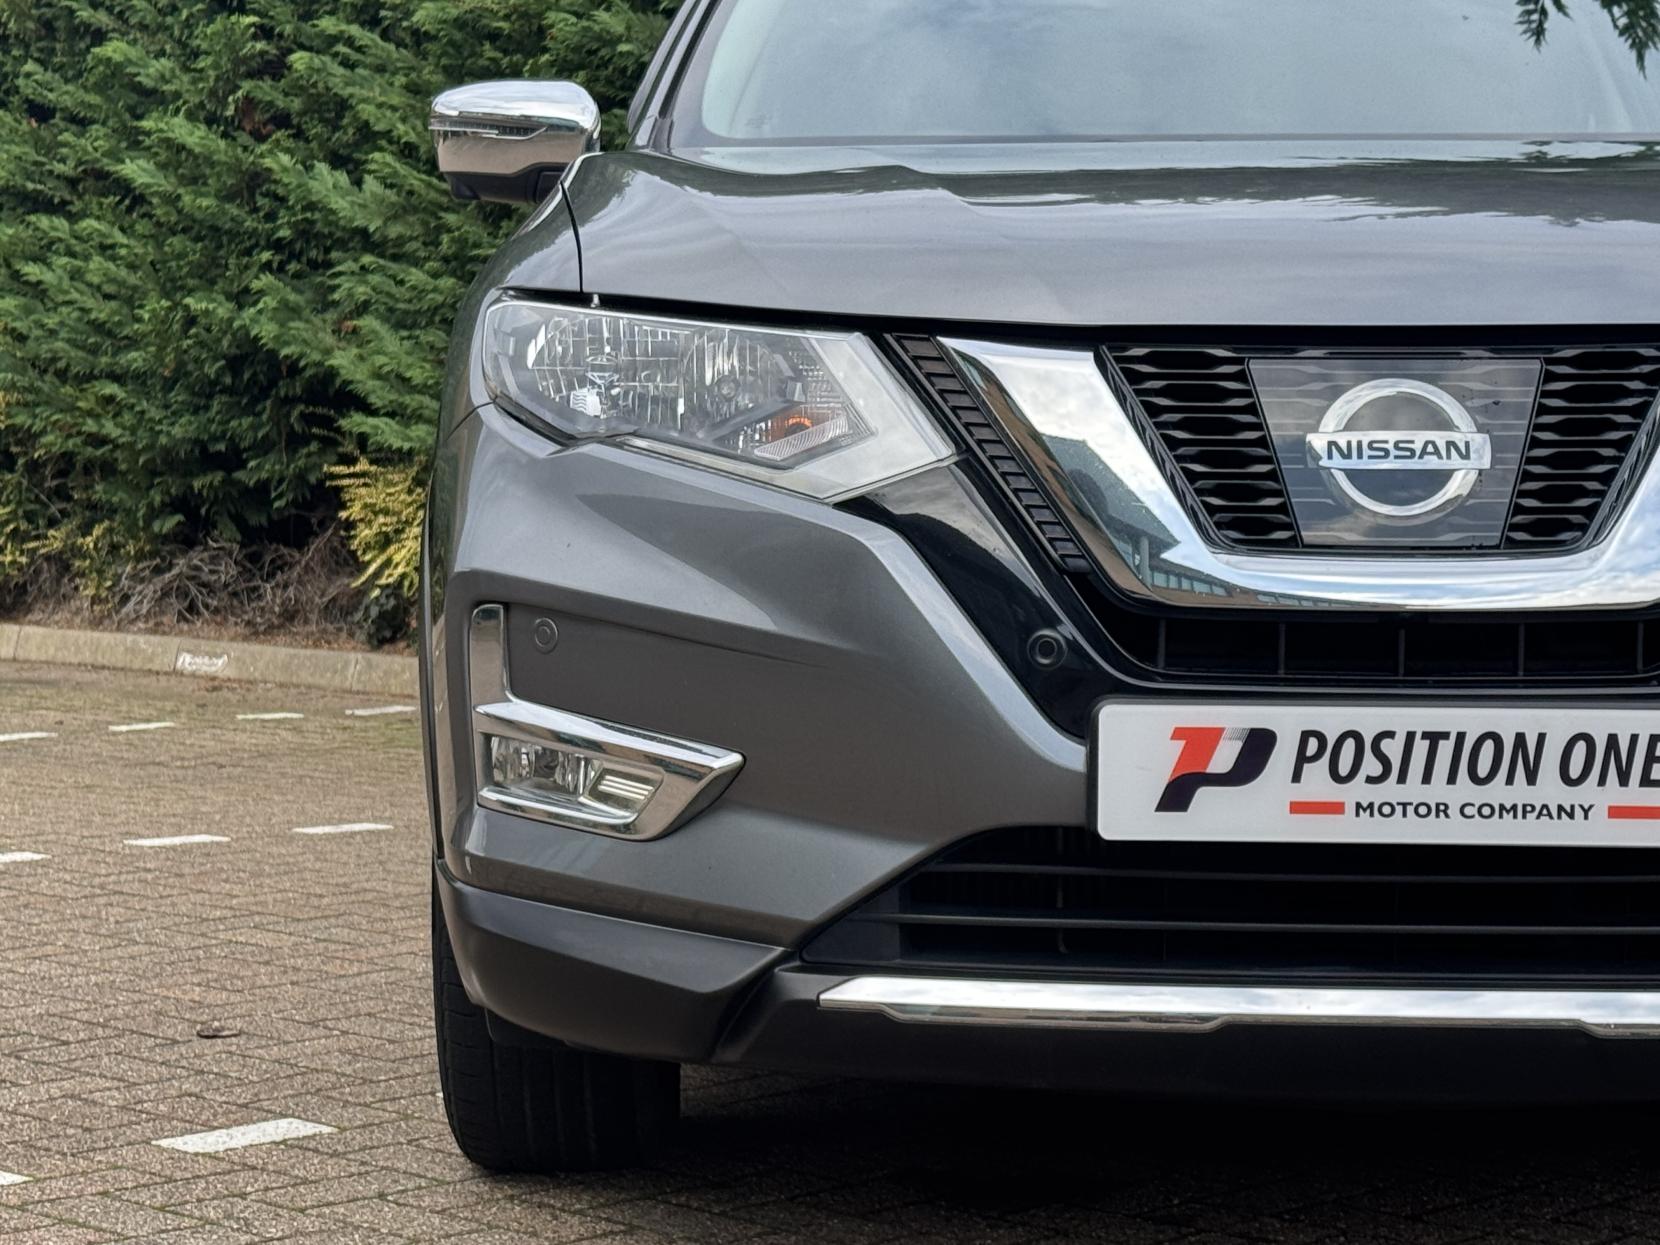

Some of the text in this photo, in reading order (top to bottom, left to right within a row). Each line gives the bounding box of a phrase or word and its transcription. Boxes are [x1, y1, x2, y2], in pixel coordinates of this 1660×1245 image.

[1327, 439, 1471, 461] NISSAN
[1290, 729, 1660, 789] POSITION ONE
[1354, 801, 1596, 821] MOTOR COMPANY
